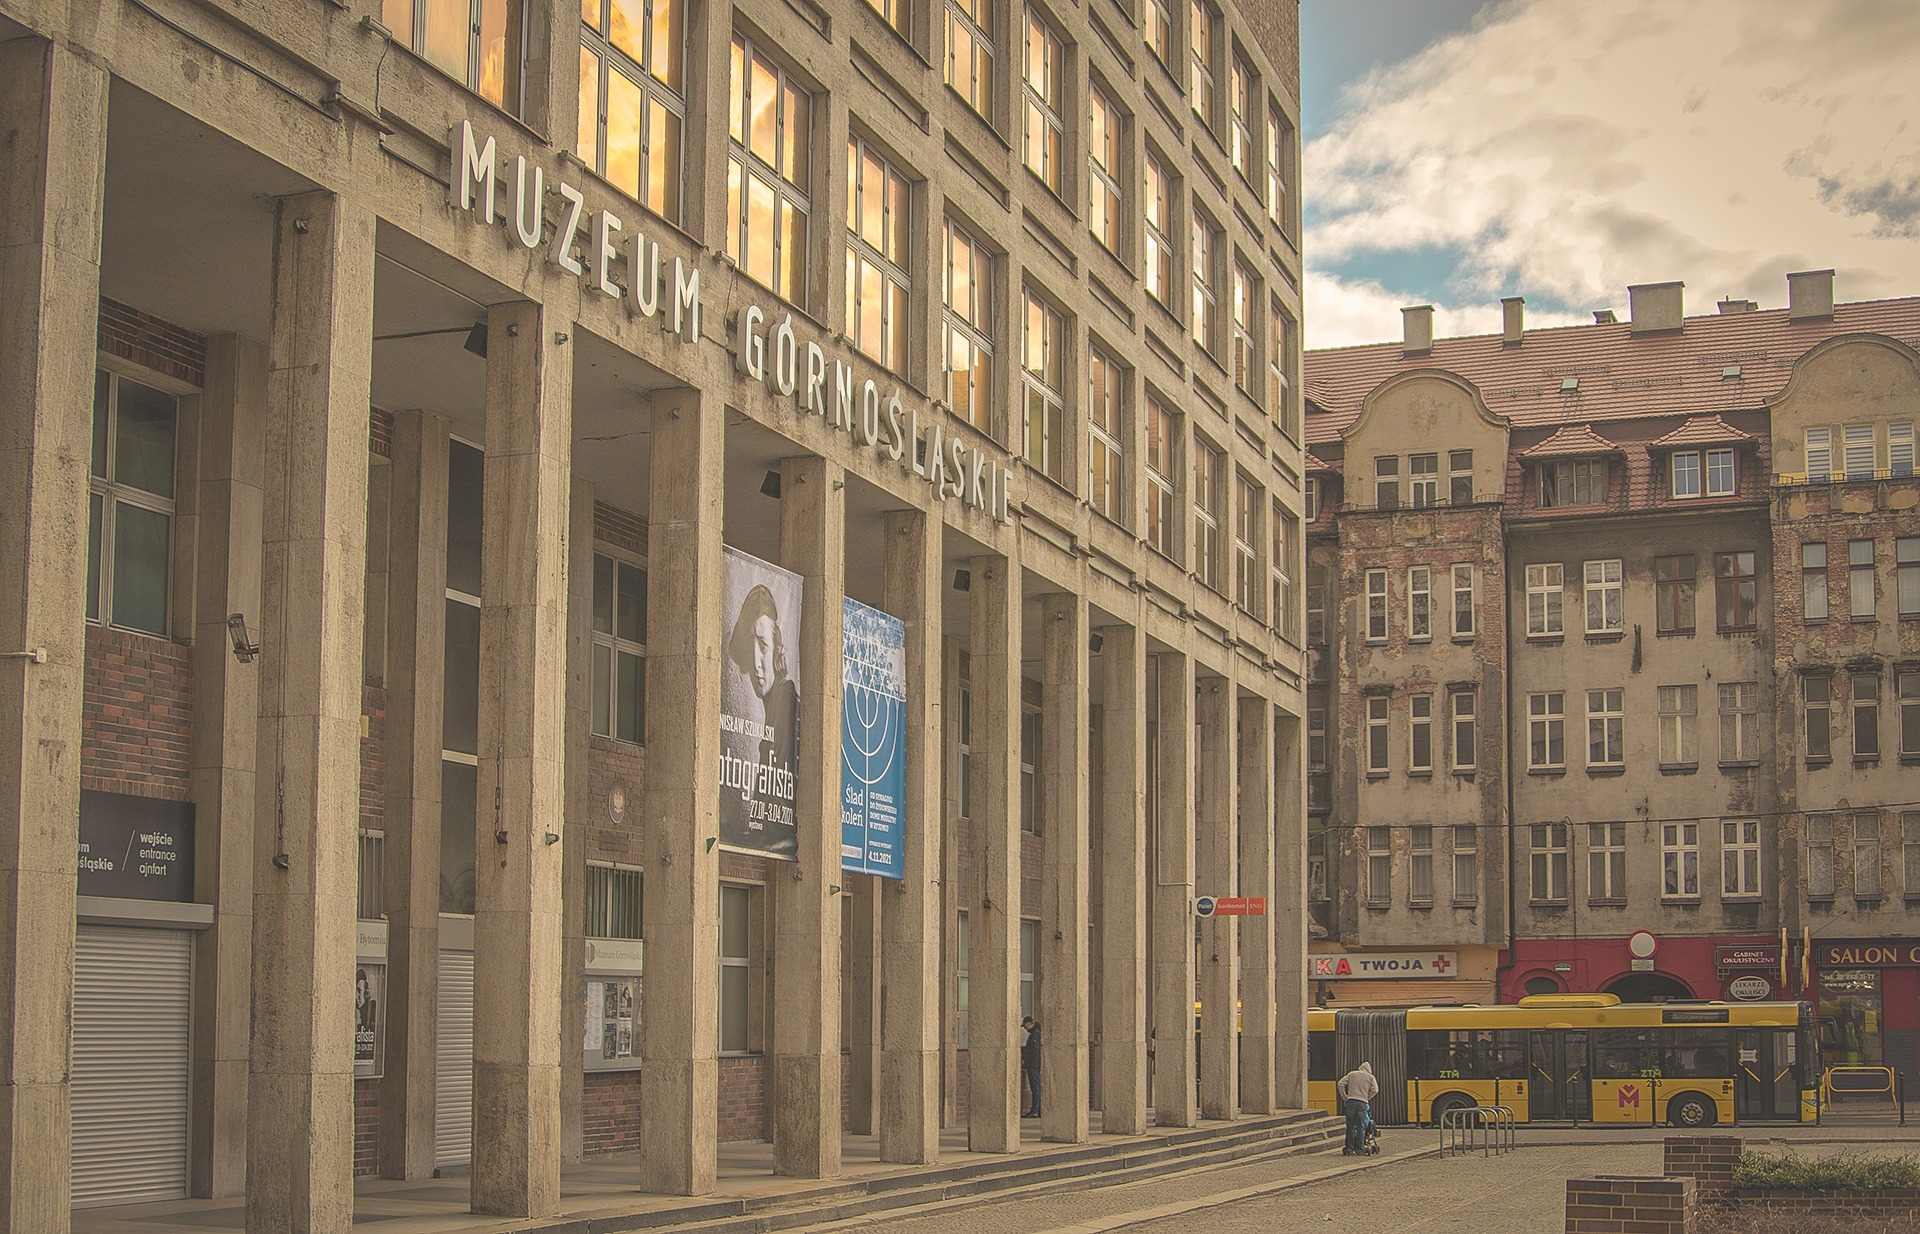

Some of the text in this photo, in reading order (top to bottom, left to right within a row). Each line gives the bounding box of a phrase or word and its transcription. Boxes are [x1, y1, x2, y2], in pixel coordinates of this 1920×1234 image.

[452, 119, 1014, 526] MUZEUM GÓRNOŚLĄSKIE
[744, 719, 775, 743] SZUKALSKI
[845, 783, 864, 806] Ślad
[139, 831, 173, 847] wejście
[139, 849, 177, 862] entrance
[868, 850, 892, 865] 4.11.2021
[79, 856, 114, 873] śląskie
[139, 862, 167, 878] ajnfart
[360, 933, 386, 947] Bytomiu
[1830, 947, 1897, 964] SALON
[1307, 957, 1424, 976] KA TWOJA
[1735, 987, 1766, 996] OKULIŚCI
[1440, 1069, 1460, 1079] ZTM
[1641, 1068, 1662, 1078] ZTM
